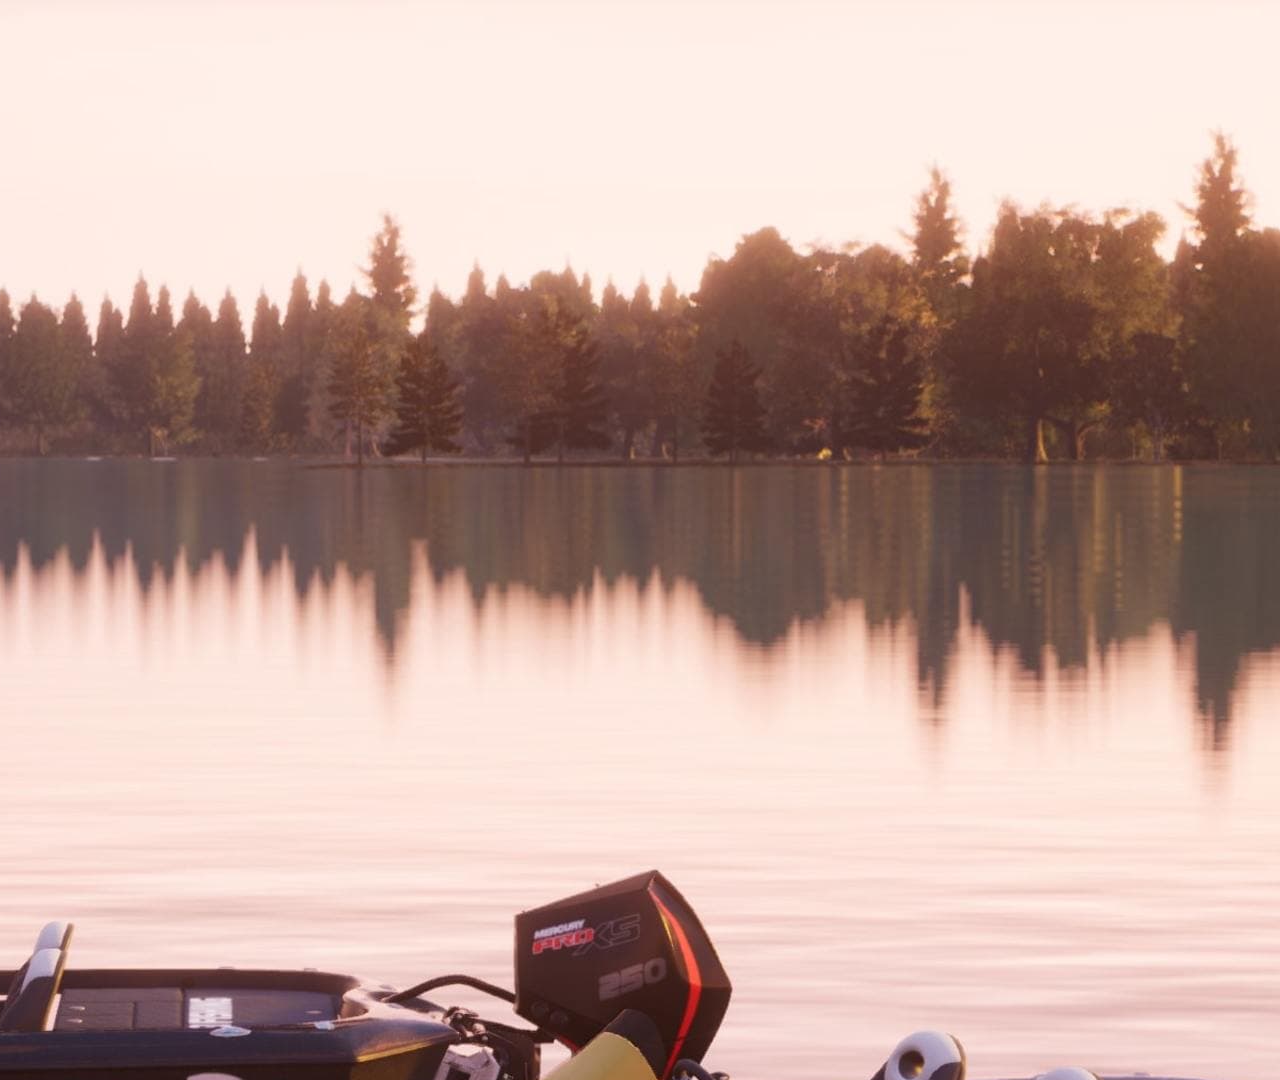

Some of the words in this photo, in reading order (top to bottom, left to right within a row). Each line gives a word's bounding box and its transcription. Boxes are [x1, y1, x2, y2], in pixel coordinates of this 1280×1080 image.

[532, 928, 595, 955] PRO
[534, 919, 586, 939] MERCURY
[598, 957, 667, 1001] 250
